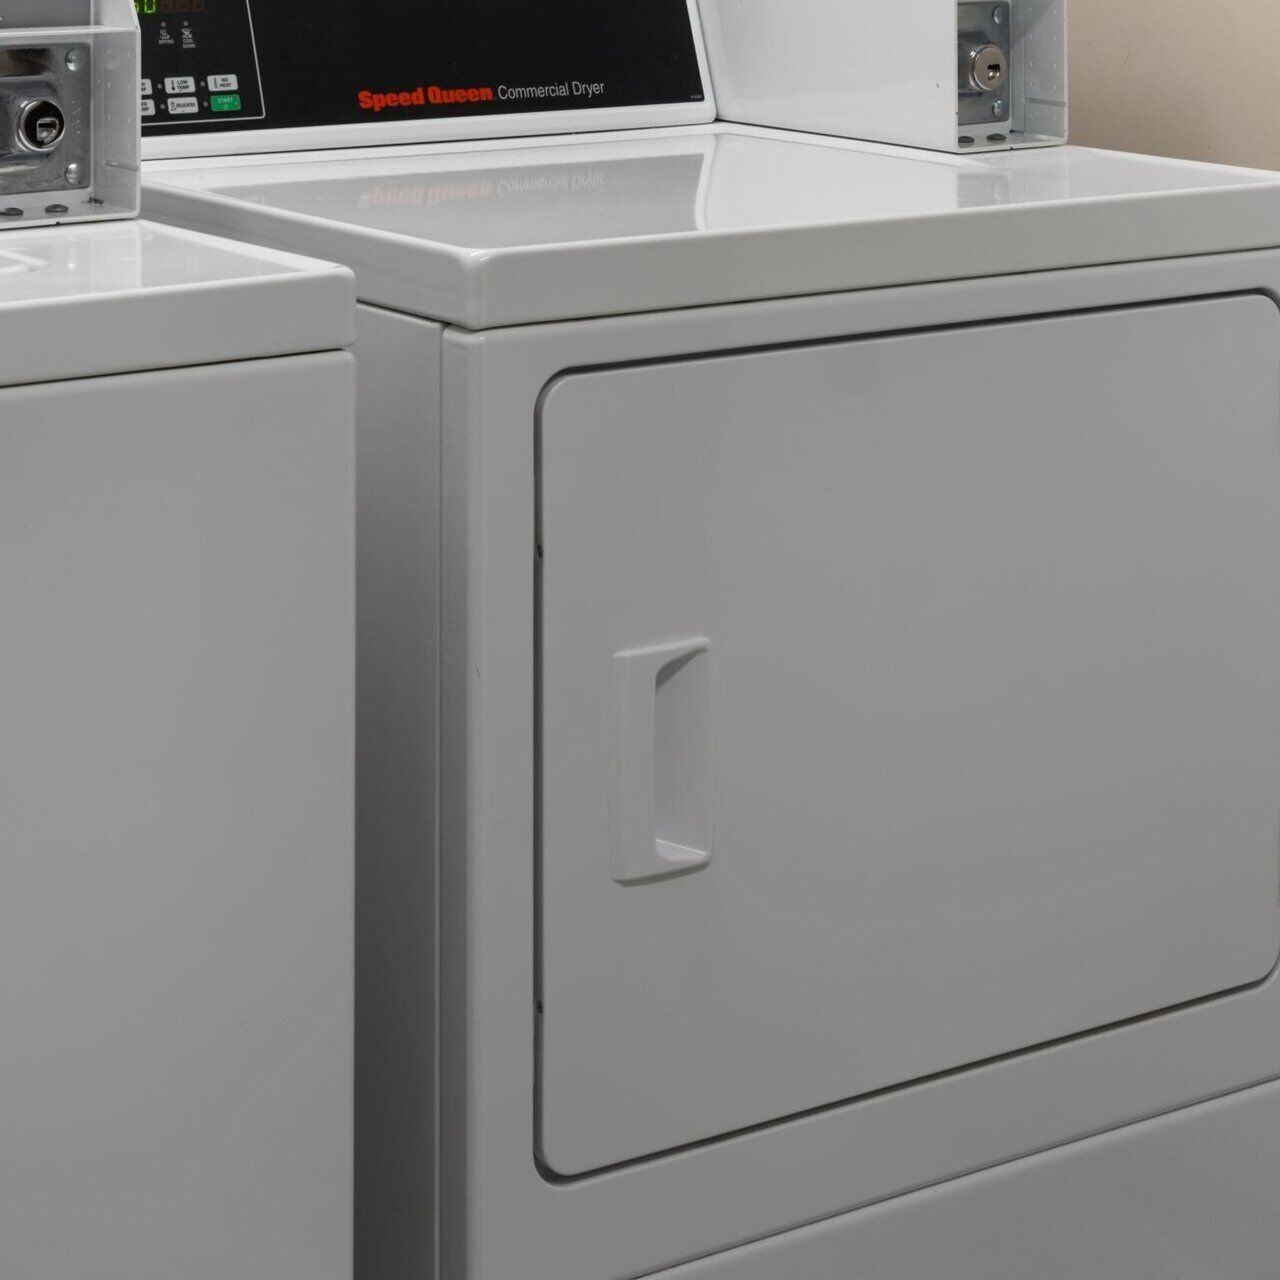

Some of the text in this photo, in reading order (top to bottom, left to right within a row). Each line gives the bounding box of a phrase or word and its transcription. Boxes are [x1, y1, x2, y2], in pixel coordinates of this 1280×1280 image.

[358, 81, 605, 111] Speed Queen Commercial Dryer
